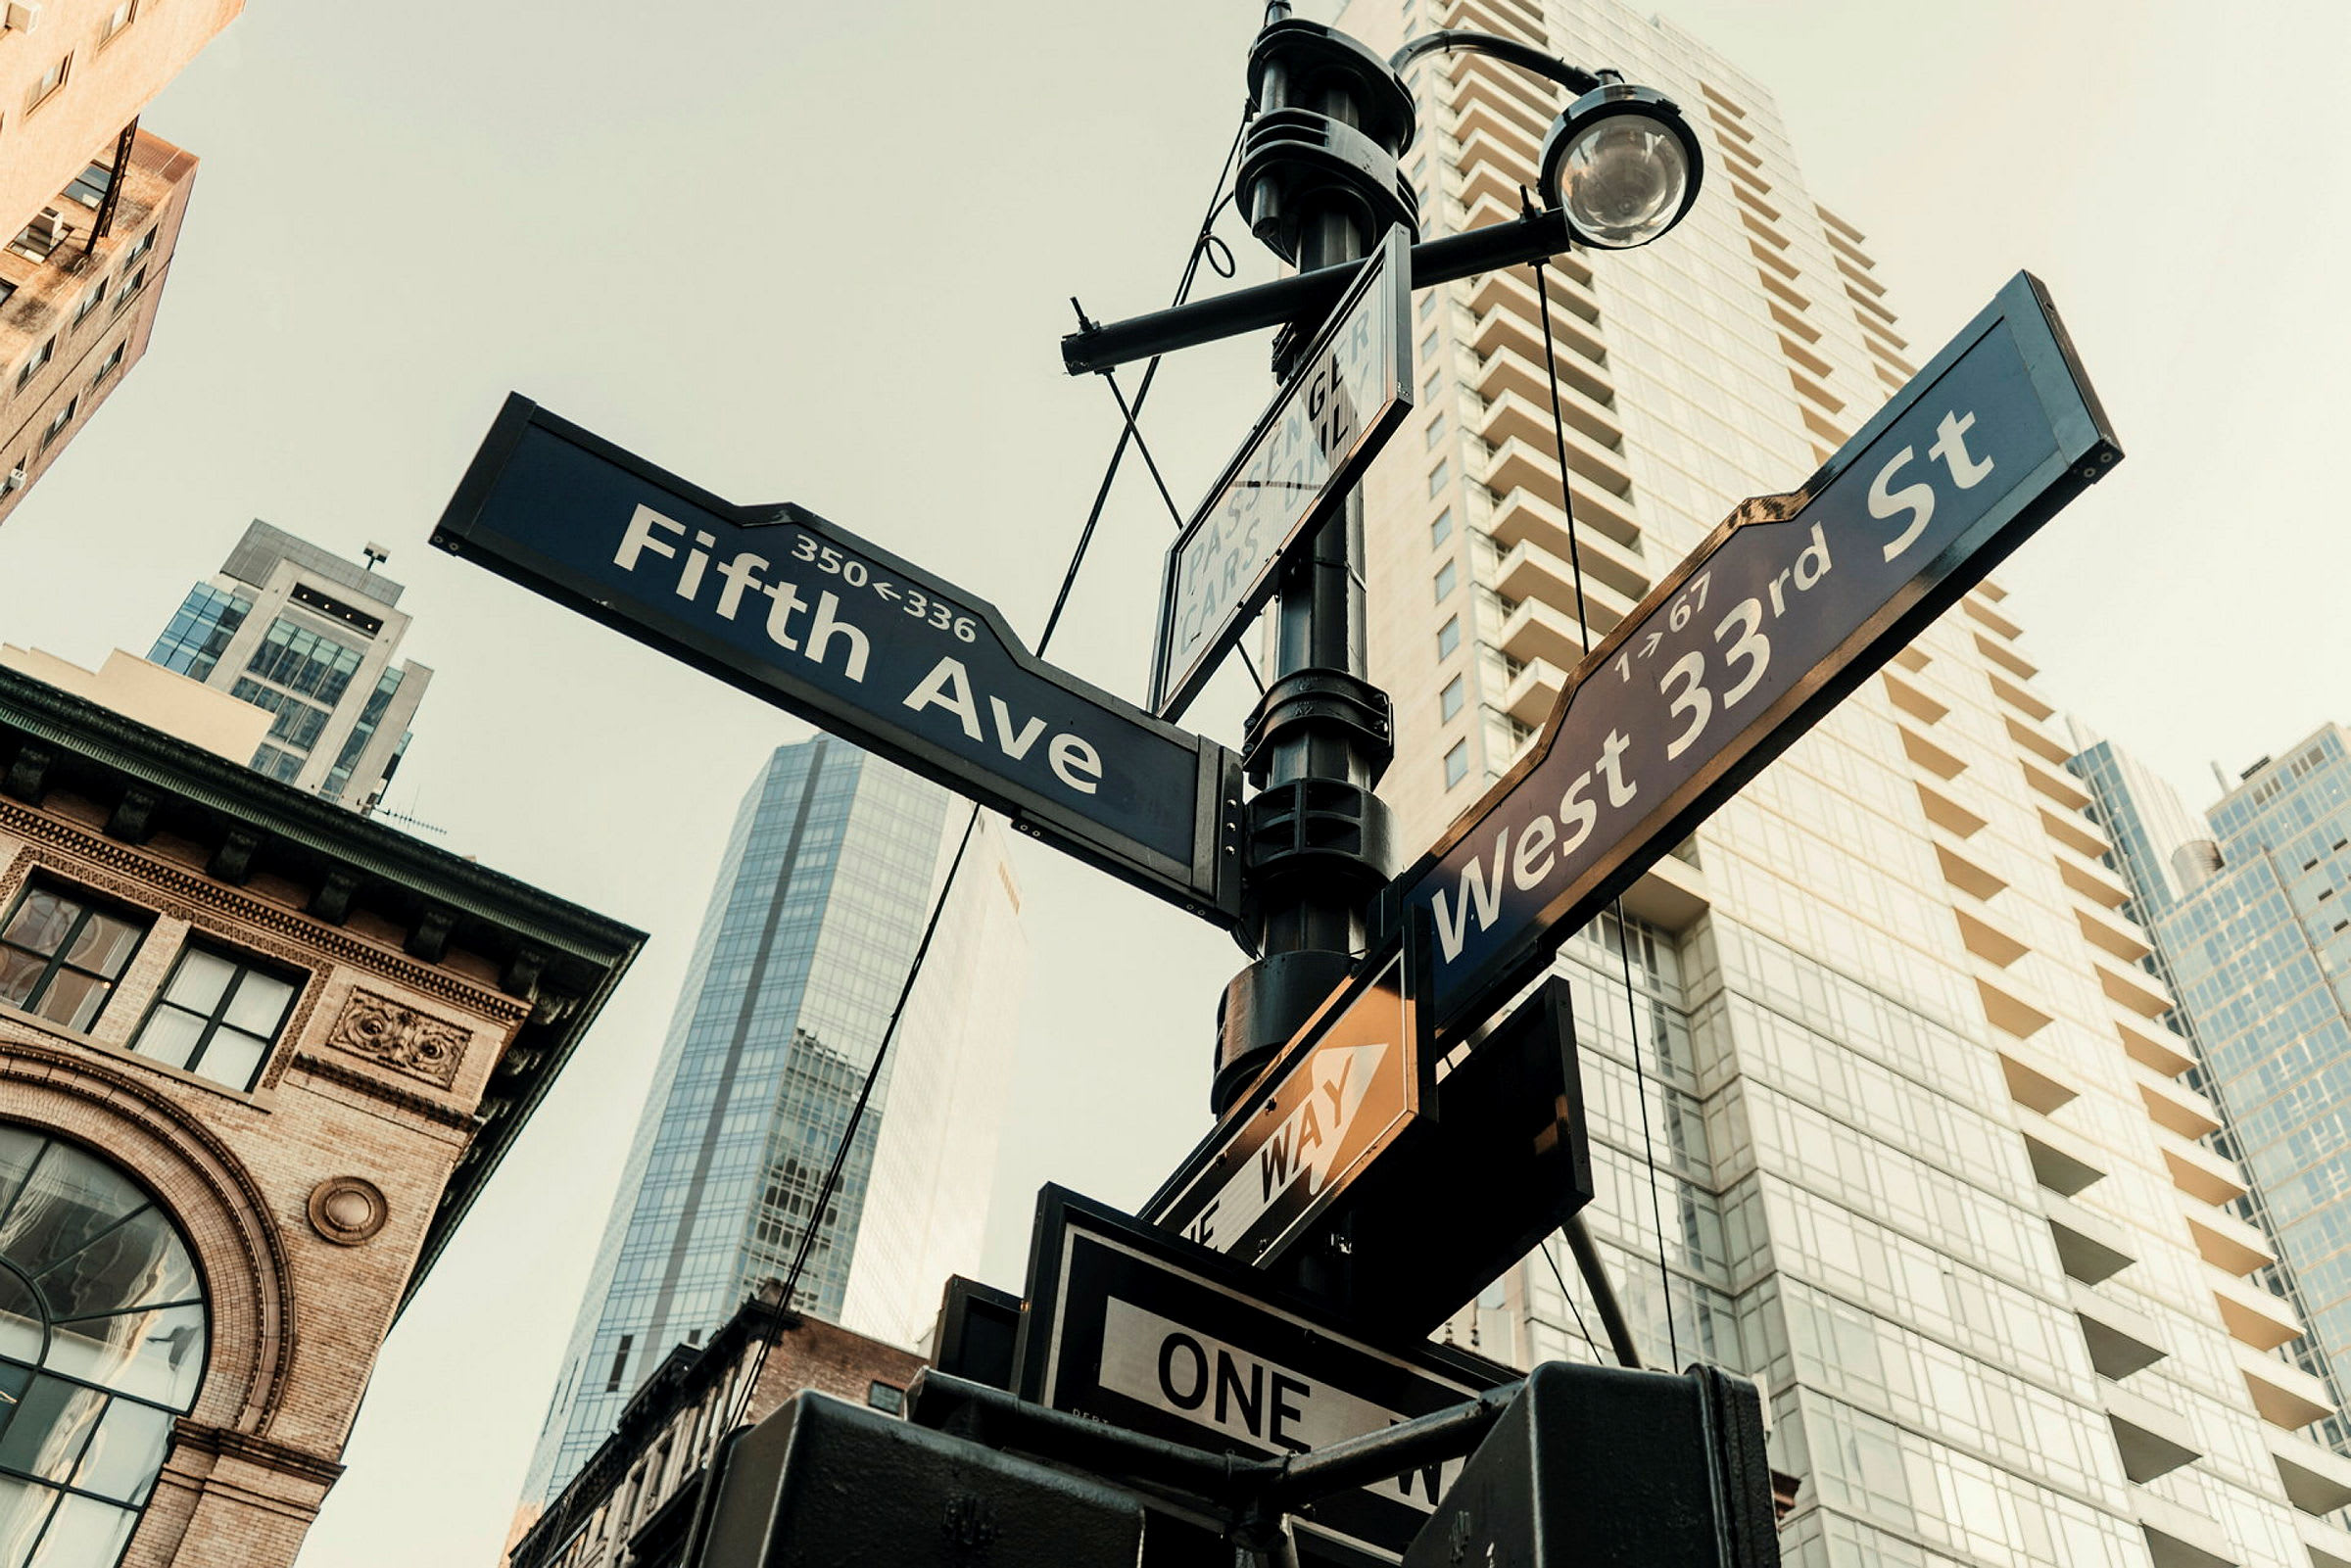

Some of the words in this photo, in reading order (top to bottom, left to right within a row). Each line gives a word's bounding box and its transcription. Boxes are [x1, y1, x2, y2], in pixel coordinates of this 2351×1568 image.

[1186, 309, 1369, 594] PASSENGER
[613, 503, 870, 683] Fifth
[902, 656, 1102, 793] Ave
[792, 535, 868, 587] 350
[902, 591, 977, 643] 336
[1181, 518, 1260, 654] CARS
[1614, 652, 1631, 683] 1
[1669, 572, 1711, 633] 67
[1431, 728, 1637, 964] West
[1659, 521, 1832, 761] 33rd
[1867, 409, 1995, 562] St
[1260, 1054, 1354, 1204] WAY
[1158, 1332, 1311, 1452] ONE
